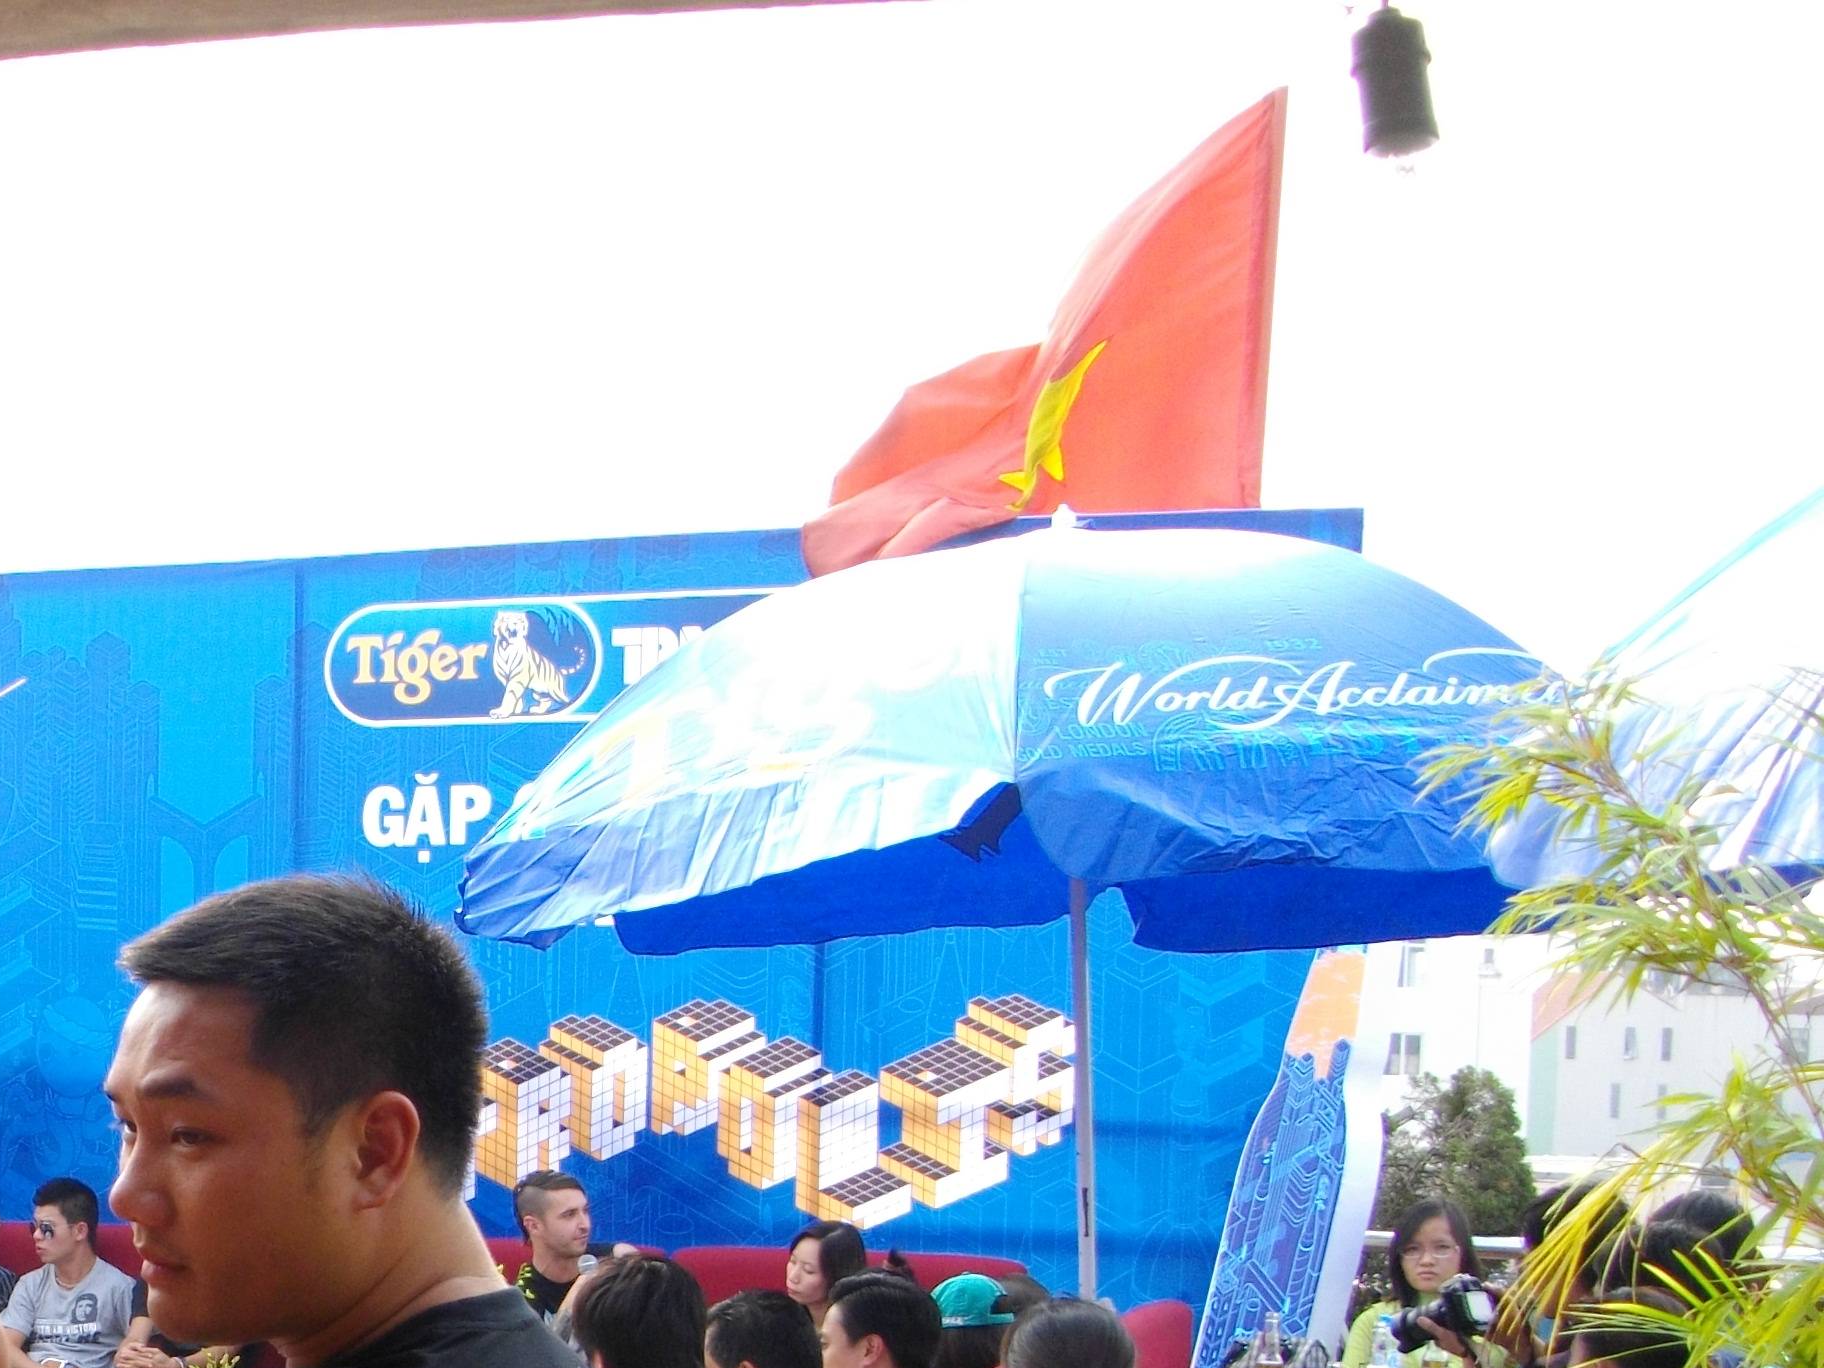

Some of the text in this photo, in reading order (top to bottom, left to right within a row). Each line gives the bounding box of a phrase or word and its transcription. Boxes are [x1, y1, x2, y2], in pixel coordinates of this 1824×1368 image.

[345, 629, 489, 705] Tiger
[1044, 655, 1302, 727] World
[1017, 744, 1063, 762] GOLD
[1067, 741, 1148, 758] MEDALS
[1055, 722, 1148, 741] LONDON
[361, 772, 493, 864] GẶP
